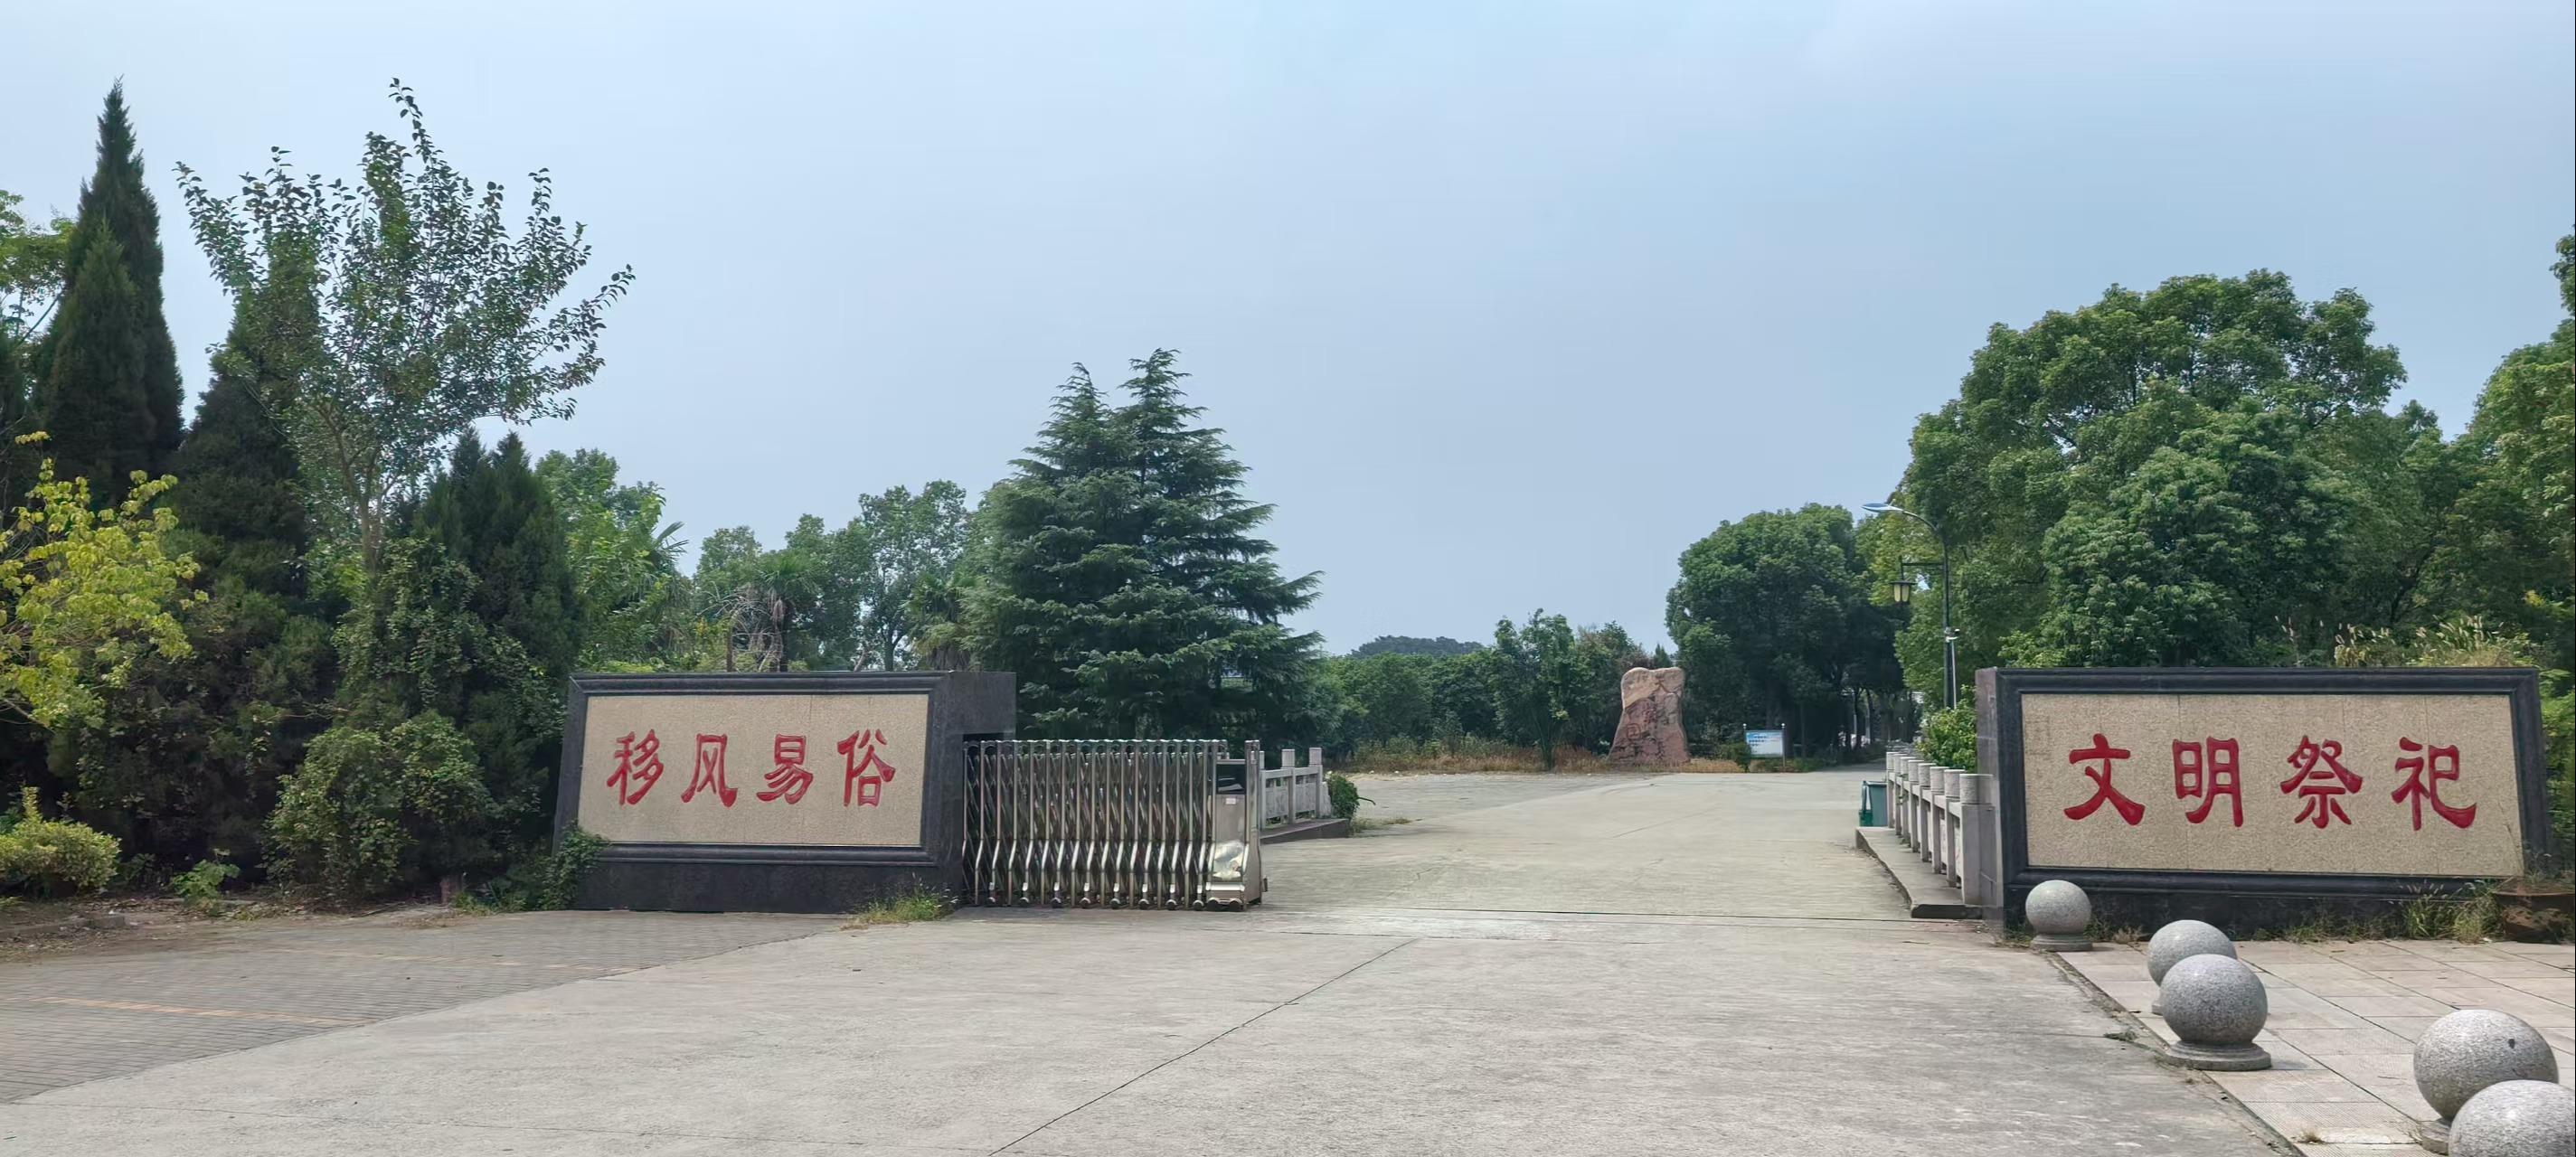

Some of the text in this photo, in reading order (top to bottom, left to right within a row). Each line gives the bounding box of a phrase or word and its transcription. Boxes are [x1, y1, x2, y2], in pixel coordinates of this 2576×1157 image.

[606, 729, 895, 809] 移风易俗
[2063, 733, 2477, 831] 文明祭祀
